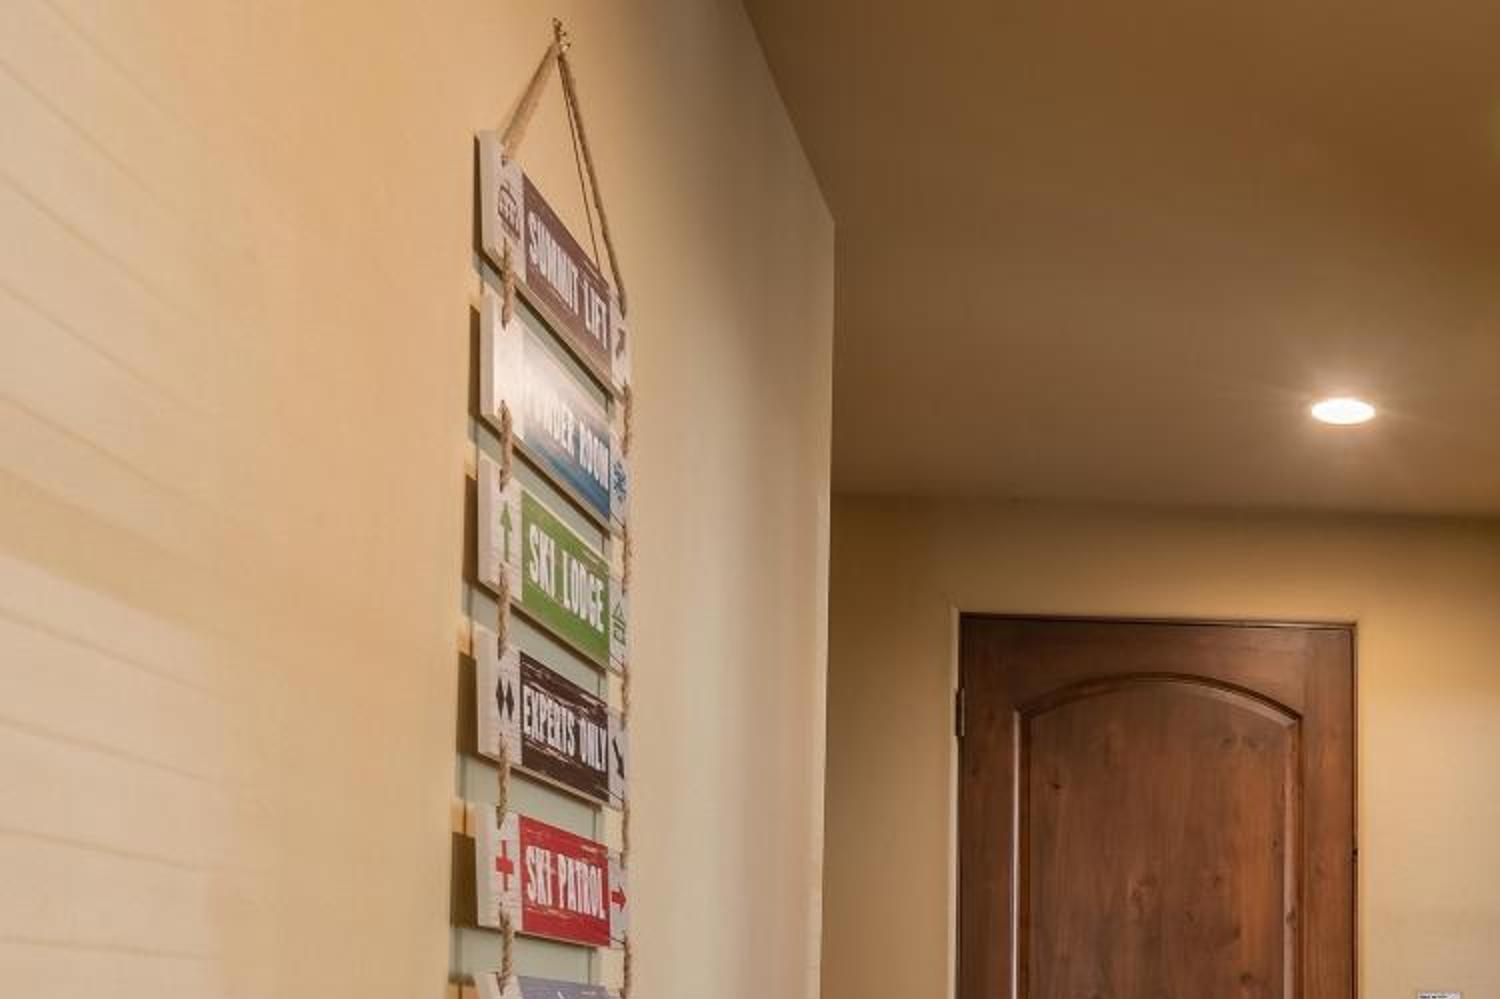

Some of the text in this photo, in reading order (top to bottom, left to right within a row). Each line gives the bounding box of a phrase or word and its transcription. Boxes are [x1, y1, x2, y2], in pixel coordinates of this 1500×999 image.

[528, 210, 608, 351] SUMMIT LIFT
[529, 523, 605, 634] SKI LODGE
[523, 684, 607, 773] EXPERTS ONLY
[525, 845, 605, 920] SKI PATROL
